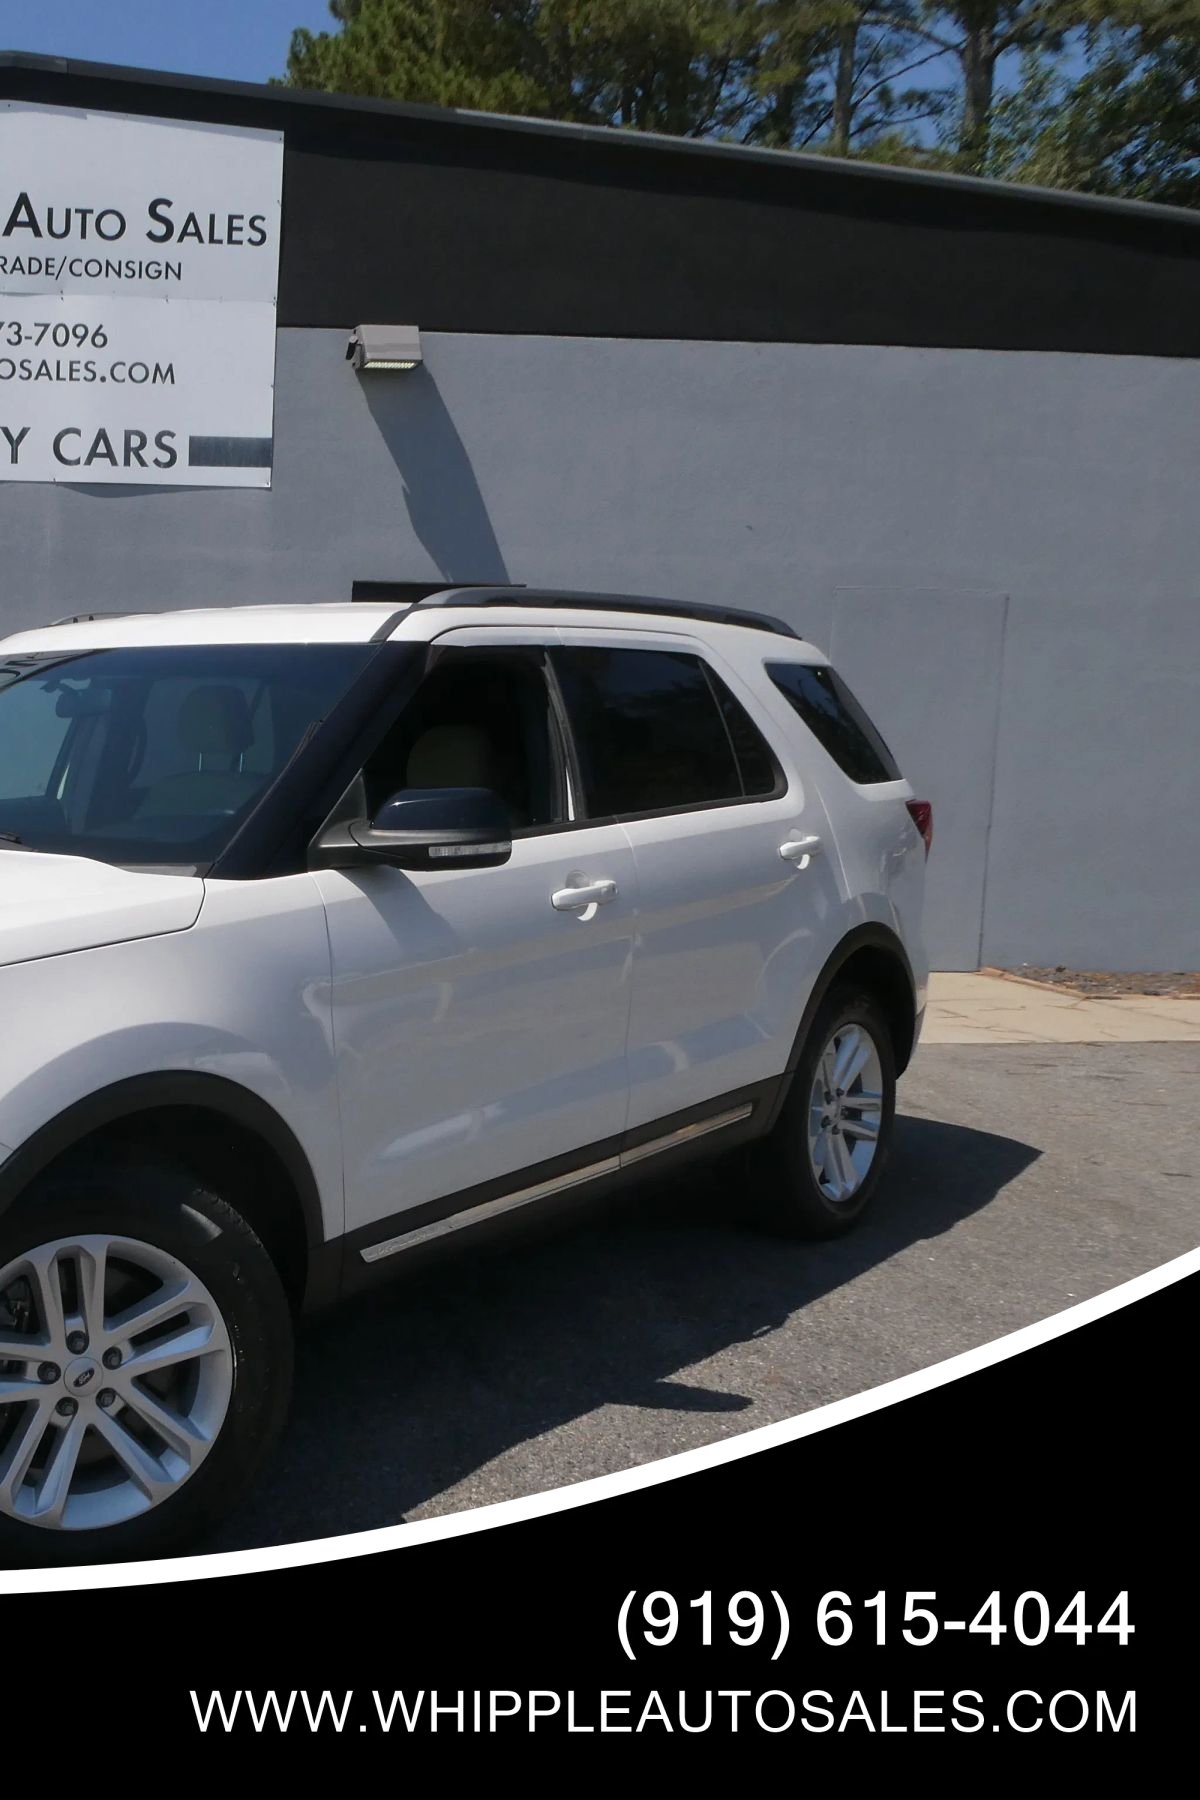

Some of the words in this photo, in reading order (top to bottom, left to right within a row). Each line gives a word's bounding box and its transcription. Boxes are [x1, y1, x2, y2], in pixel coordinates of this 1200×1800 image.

[2, 191, 127, 241] AUTO
[145, 197, 268, 247] SALES
[52, 428, 178, 469] CARS
